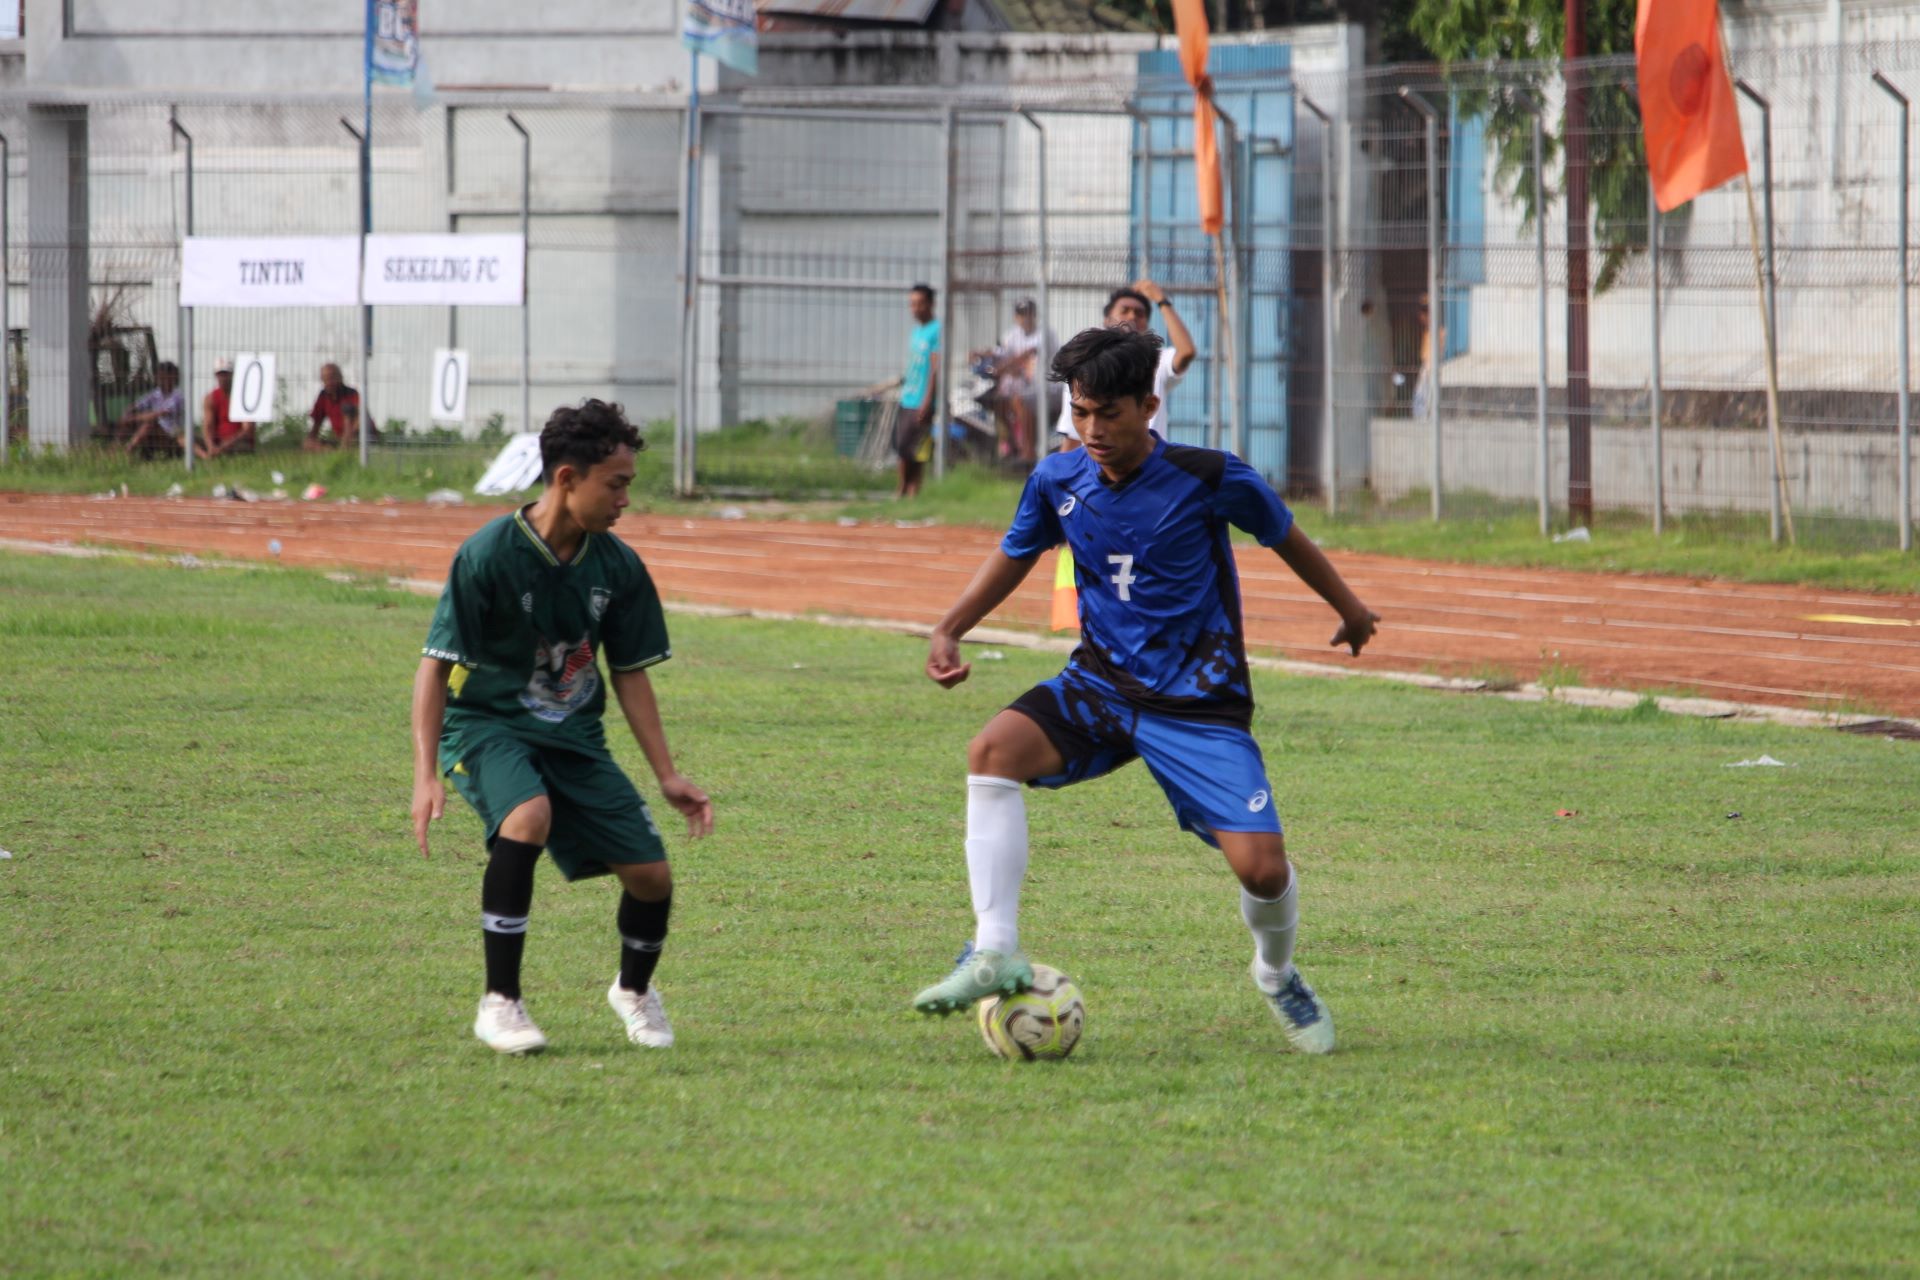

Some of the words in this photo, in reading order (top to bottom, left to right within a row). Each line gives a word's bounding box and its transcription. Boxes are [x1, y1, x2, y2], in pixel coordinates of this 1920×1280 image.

[240, 259, 304, 285] TINTIN
[476, 256, 500, 282] FC
[241, 360, 264, 414] 0
[441, 357, 460, 412] 0
[1107, 554, 1136, 601] 7
